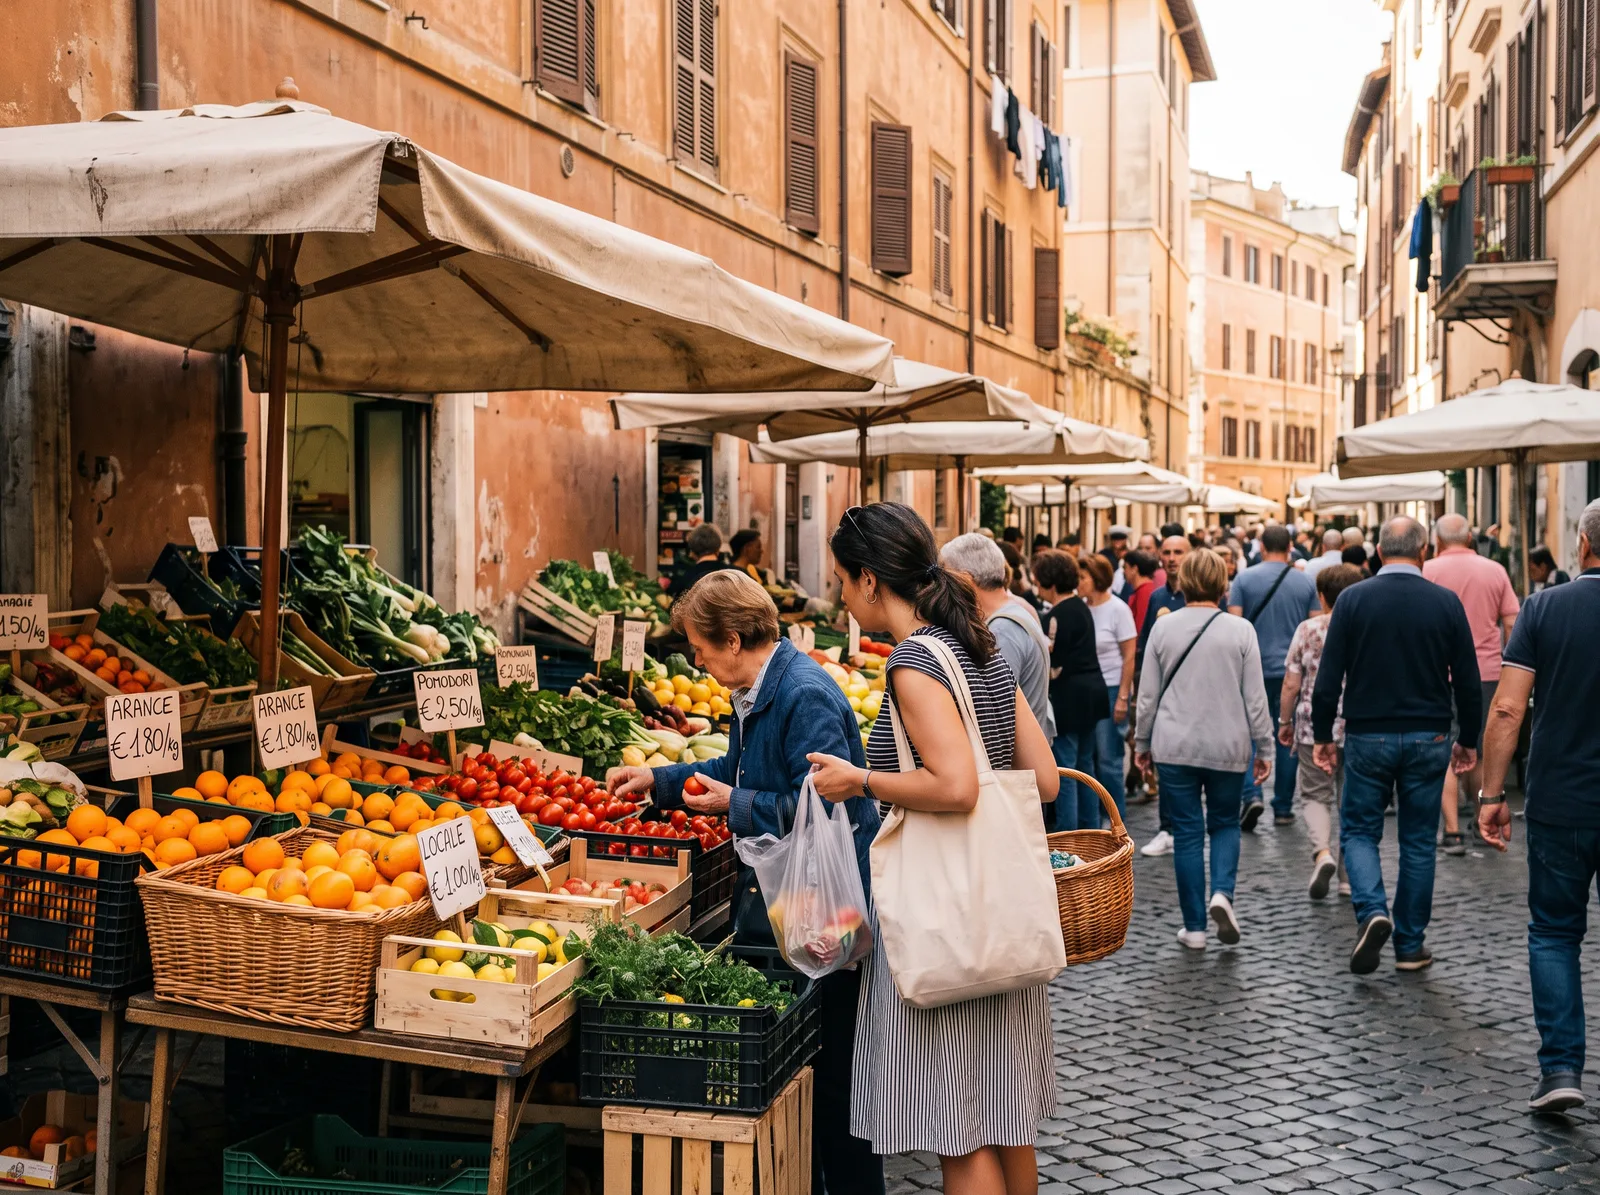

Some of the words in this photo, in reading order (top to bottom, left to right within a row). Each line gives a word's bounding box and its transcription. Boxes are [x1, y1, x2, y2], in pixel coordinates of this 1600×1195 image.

[111, 696, 173, 720] ARANCE
[258, 692, 306, 718] ARANCE
[421, 823, 466, 860] LOCALE
